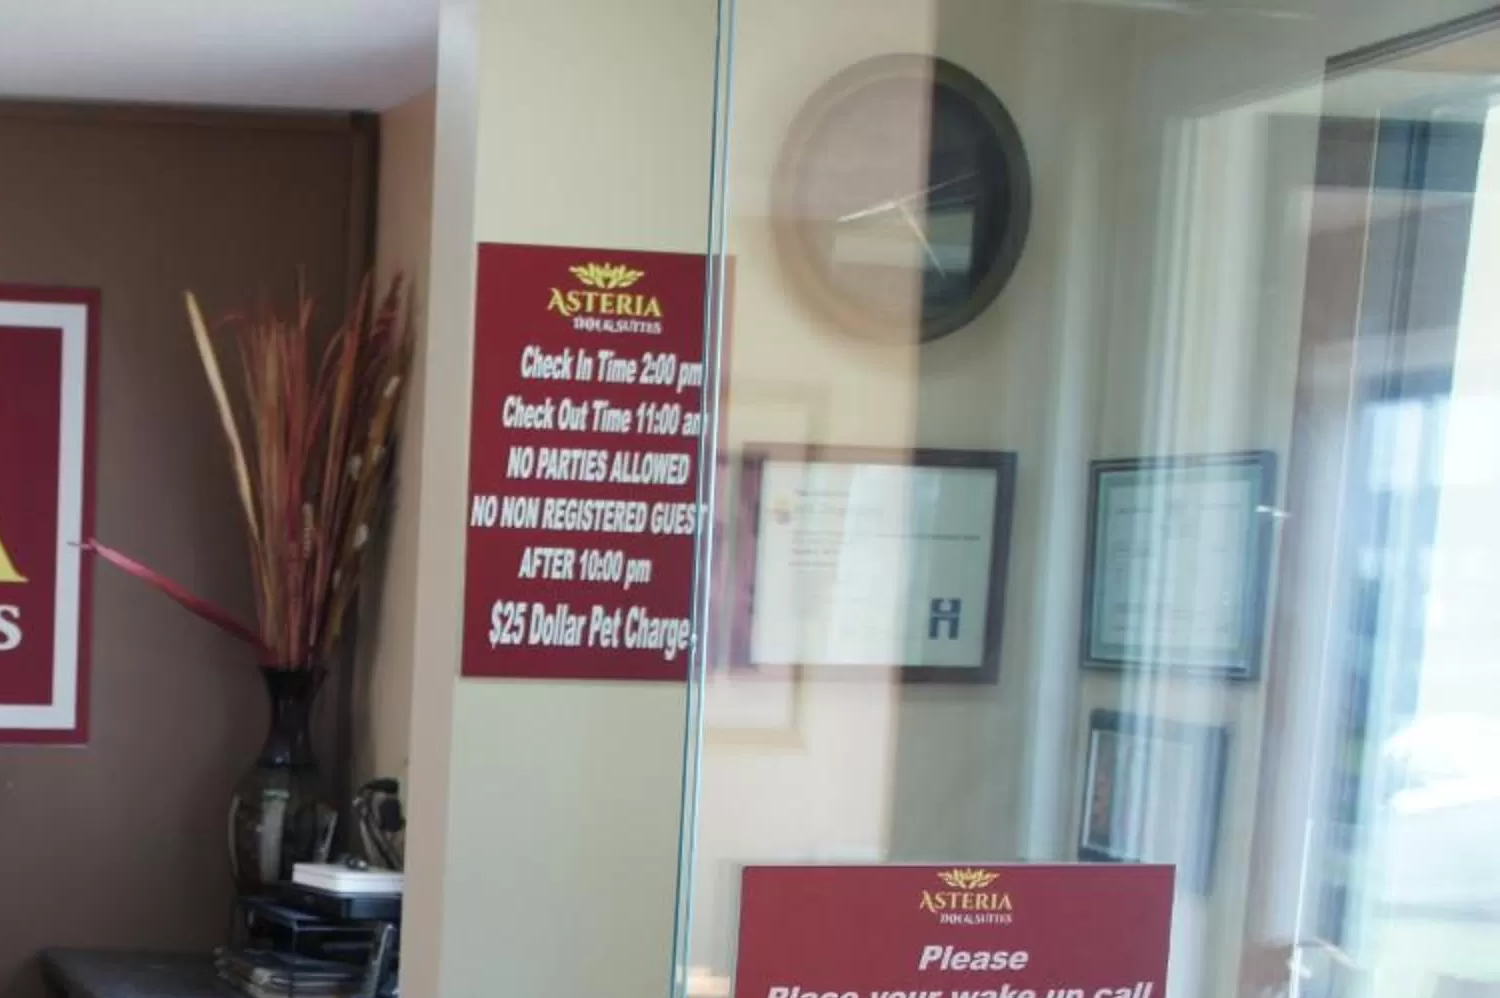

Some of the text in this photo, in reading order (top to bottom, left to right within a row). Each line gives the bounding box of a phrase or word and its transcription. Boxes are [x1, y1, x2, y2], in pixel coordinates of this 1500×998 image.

[547, 287, 663, 317] ASTERIA
[520, 345, 703, 394] Check In Time 2:00 pm
[502, 395, 553, 431] Check
[557, 399, 587, 431] Out
[592, 399, 632, 433] Time
[636, 401, 681, 436] 11:00
[507, 446, 690, 485] NO PARTIES ALLOWED
[471, 495, 498, 528] NO
[500, 496, 539, 530] NON
[542, 498, 648, 533] REGISTERED
[518, 546, 652, 590] AFTER 10:00 pm
[489, 599, 528, 650] $25
[528, 601, 588, 647] Dollar
[588, 604, 622, 648] Pet
[919, 888, 1013, 914] ASTERIA
[918, 945, 1028, 971] Please
